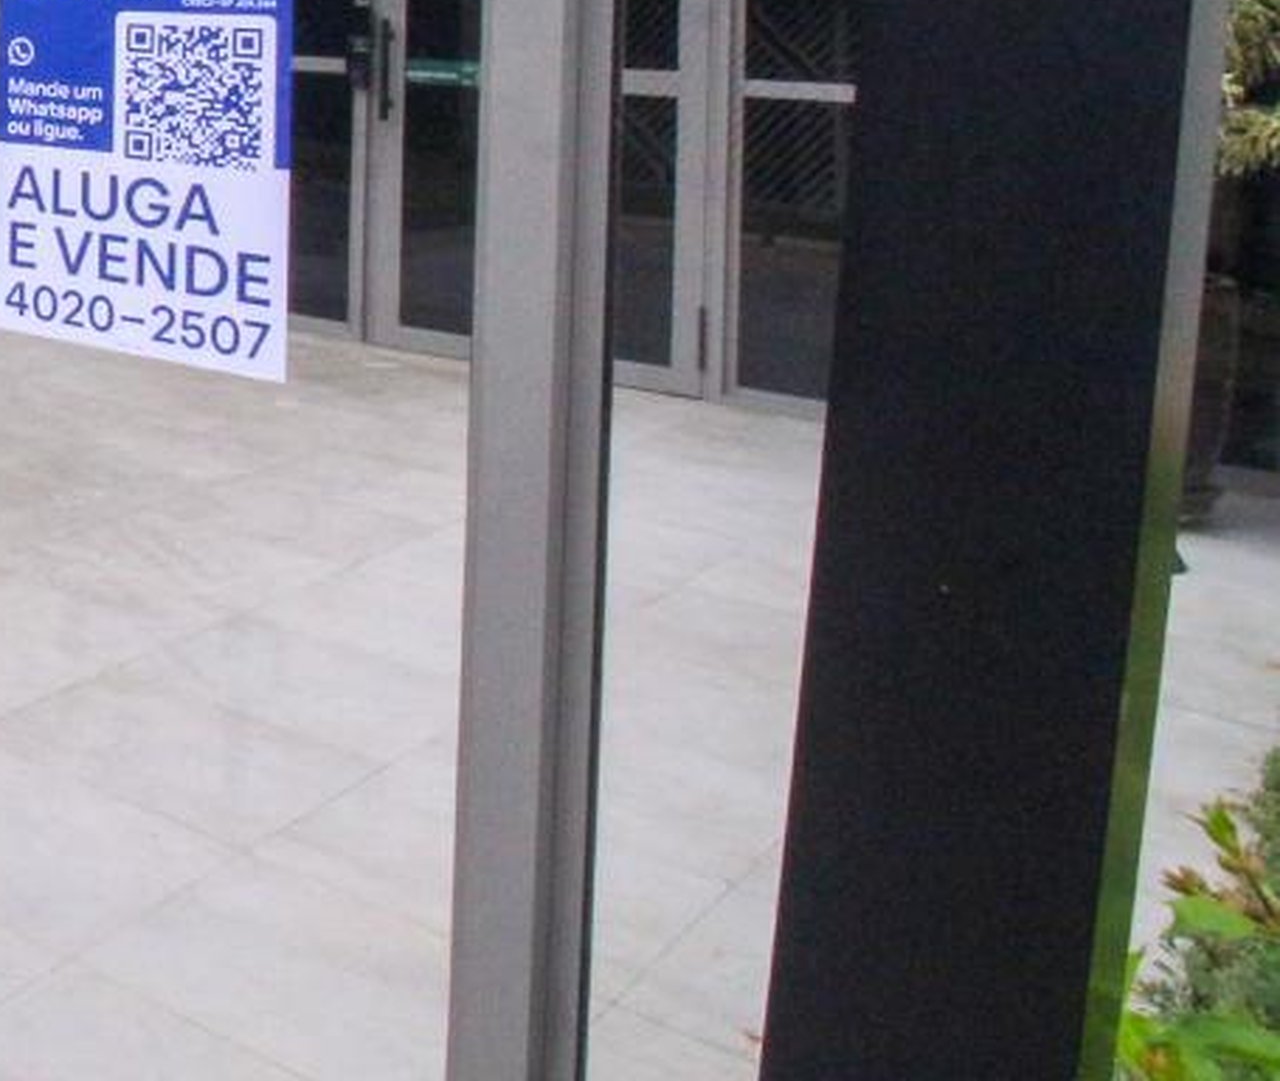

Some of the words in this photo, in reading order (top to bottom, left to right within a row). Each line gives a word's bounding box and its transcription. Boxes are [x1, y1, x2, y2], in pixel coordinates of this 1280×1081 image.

[7, 77, 71, 99] Mande
[73, 84, 103, 101] um
[7, 99, 104, 124] Whatsapp
[7, 122, 33, 137] ou
[34, 119, 84, 142] ligue.
[7, 165, 221, 236] ALUGA
[9, 222, 37, 269] E
[55, 226, 272, 307] VENDE
[5, 280, 272, 360] 4020-2507
